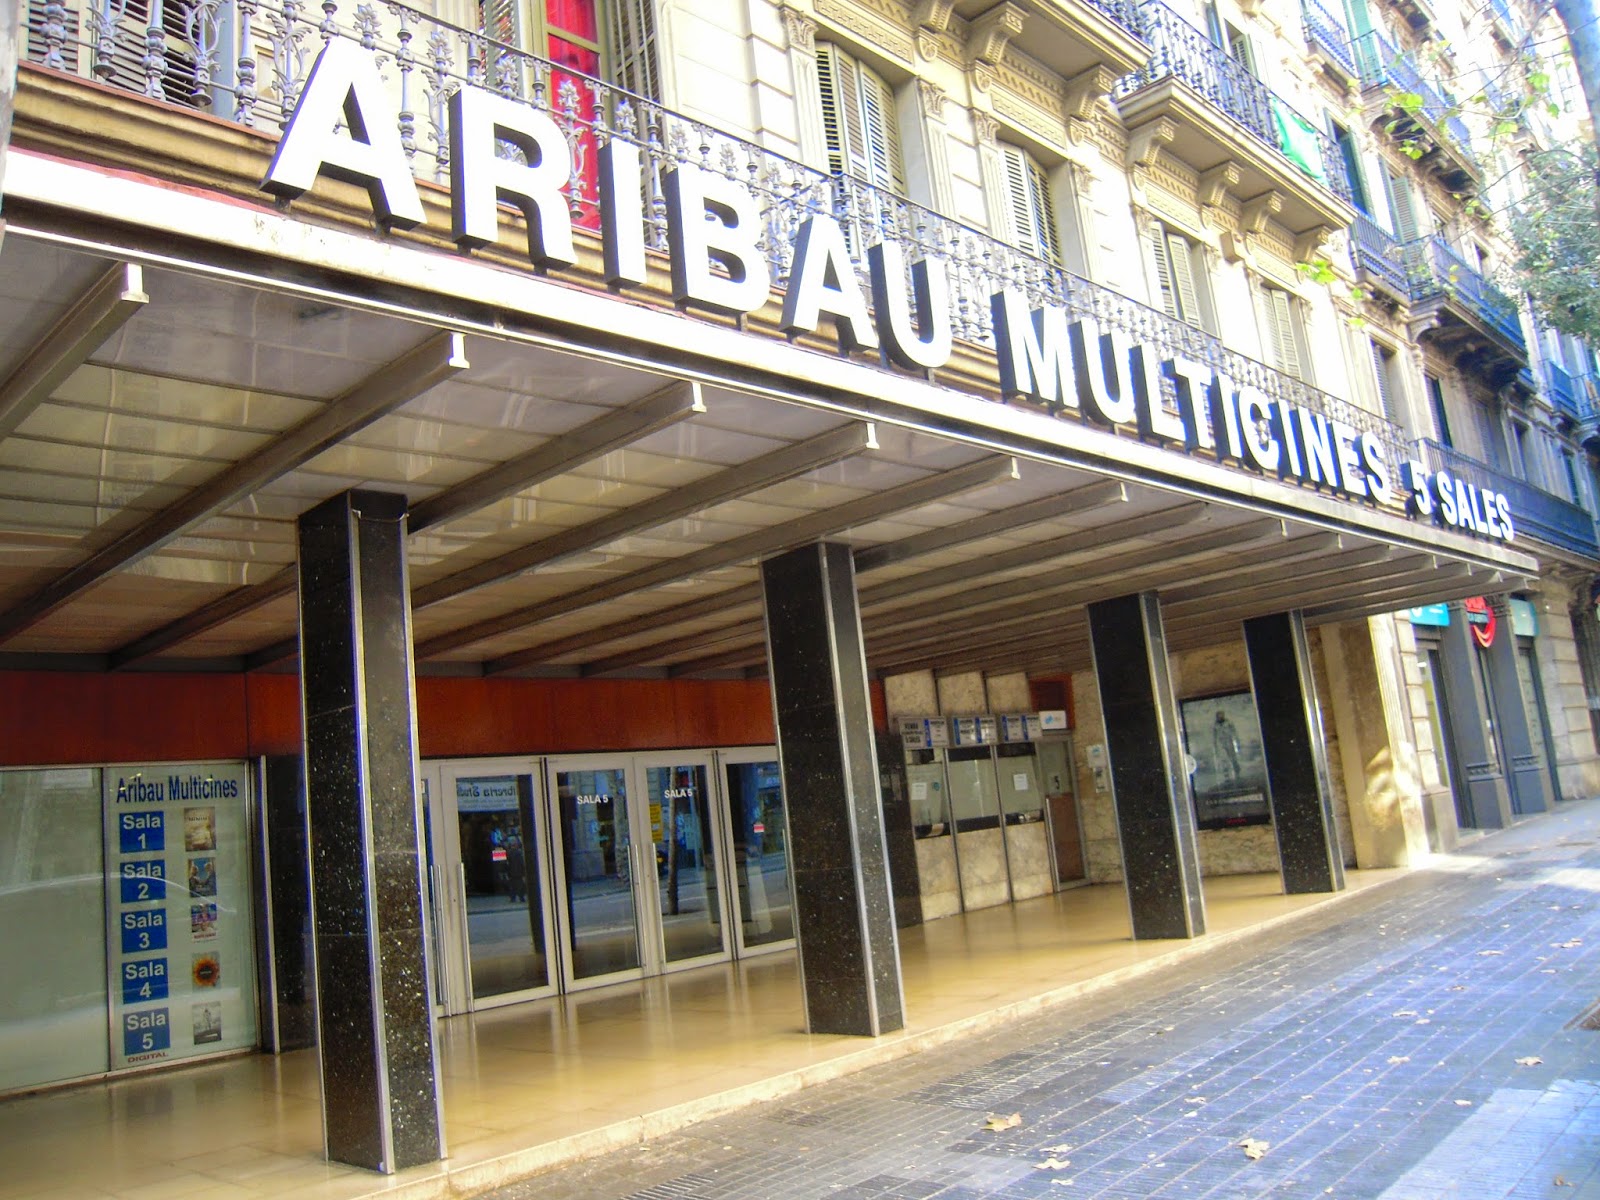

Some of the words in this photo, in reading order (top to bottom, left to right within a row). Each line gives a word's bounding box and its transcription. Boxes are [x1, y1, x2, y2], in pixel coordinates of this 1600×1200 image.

[261, 37, 953, 369] ARIBAU
[991, 286, 1392, 506] MULTICINES
[1402, 459, 1432, 516] 5
[1433, 470, 1515, 542] SALES
[116, 774, 165, 803] Aribau
[168, 774, 239, 801] Multicines
[663, 788, 687, 799] SALA
[687, 788, 693, 797] 5
[576, 795, 602, 805] SALA
[603, 794, 609, 804] 5
[123, 813, 162, 830] Sala
[137, 833, 147, 849] 1
[123, 862, 162, 879] Sala
[137, 882, 149, 900] 2
[124, 911, 164, 930] Sala
[138, 932, 150, 949] 3
[125, 962, 165, 980] Sala
[139, 982, 152, 998] 4
[127, 1012, 167, 1031] Sala
[142, 1033, 154, 1050] 5
[126, 1053, 169, 1064] DIGITAL
